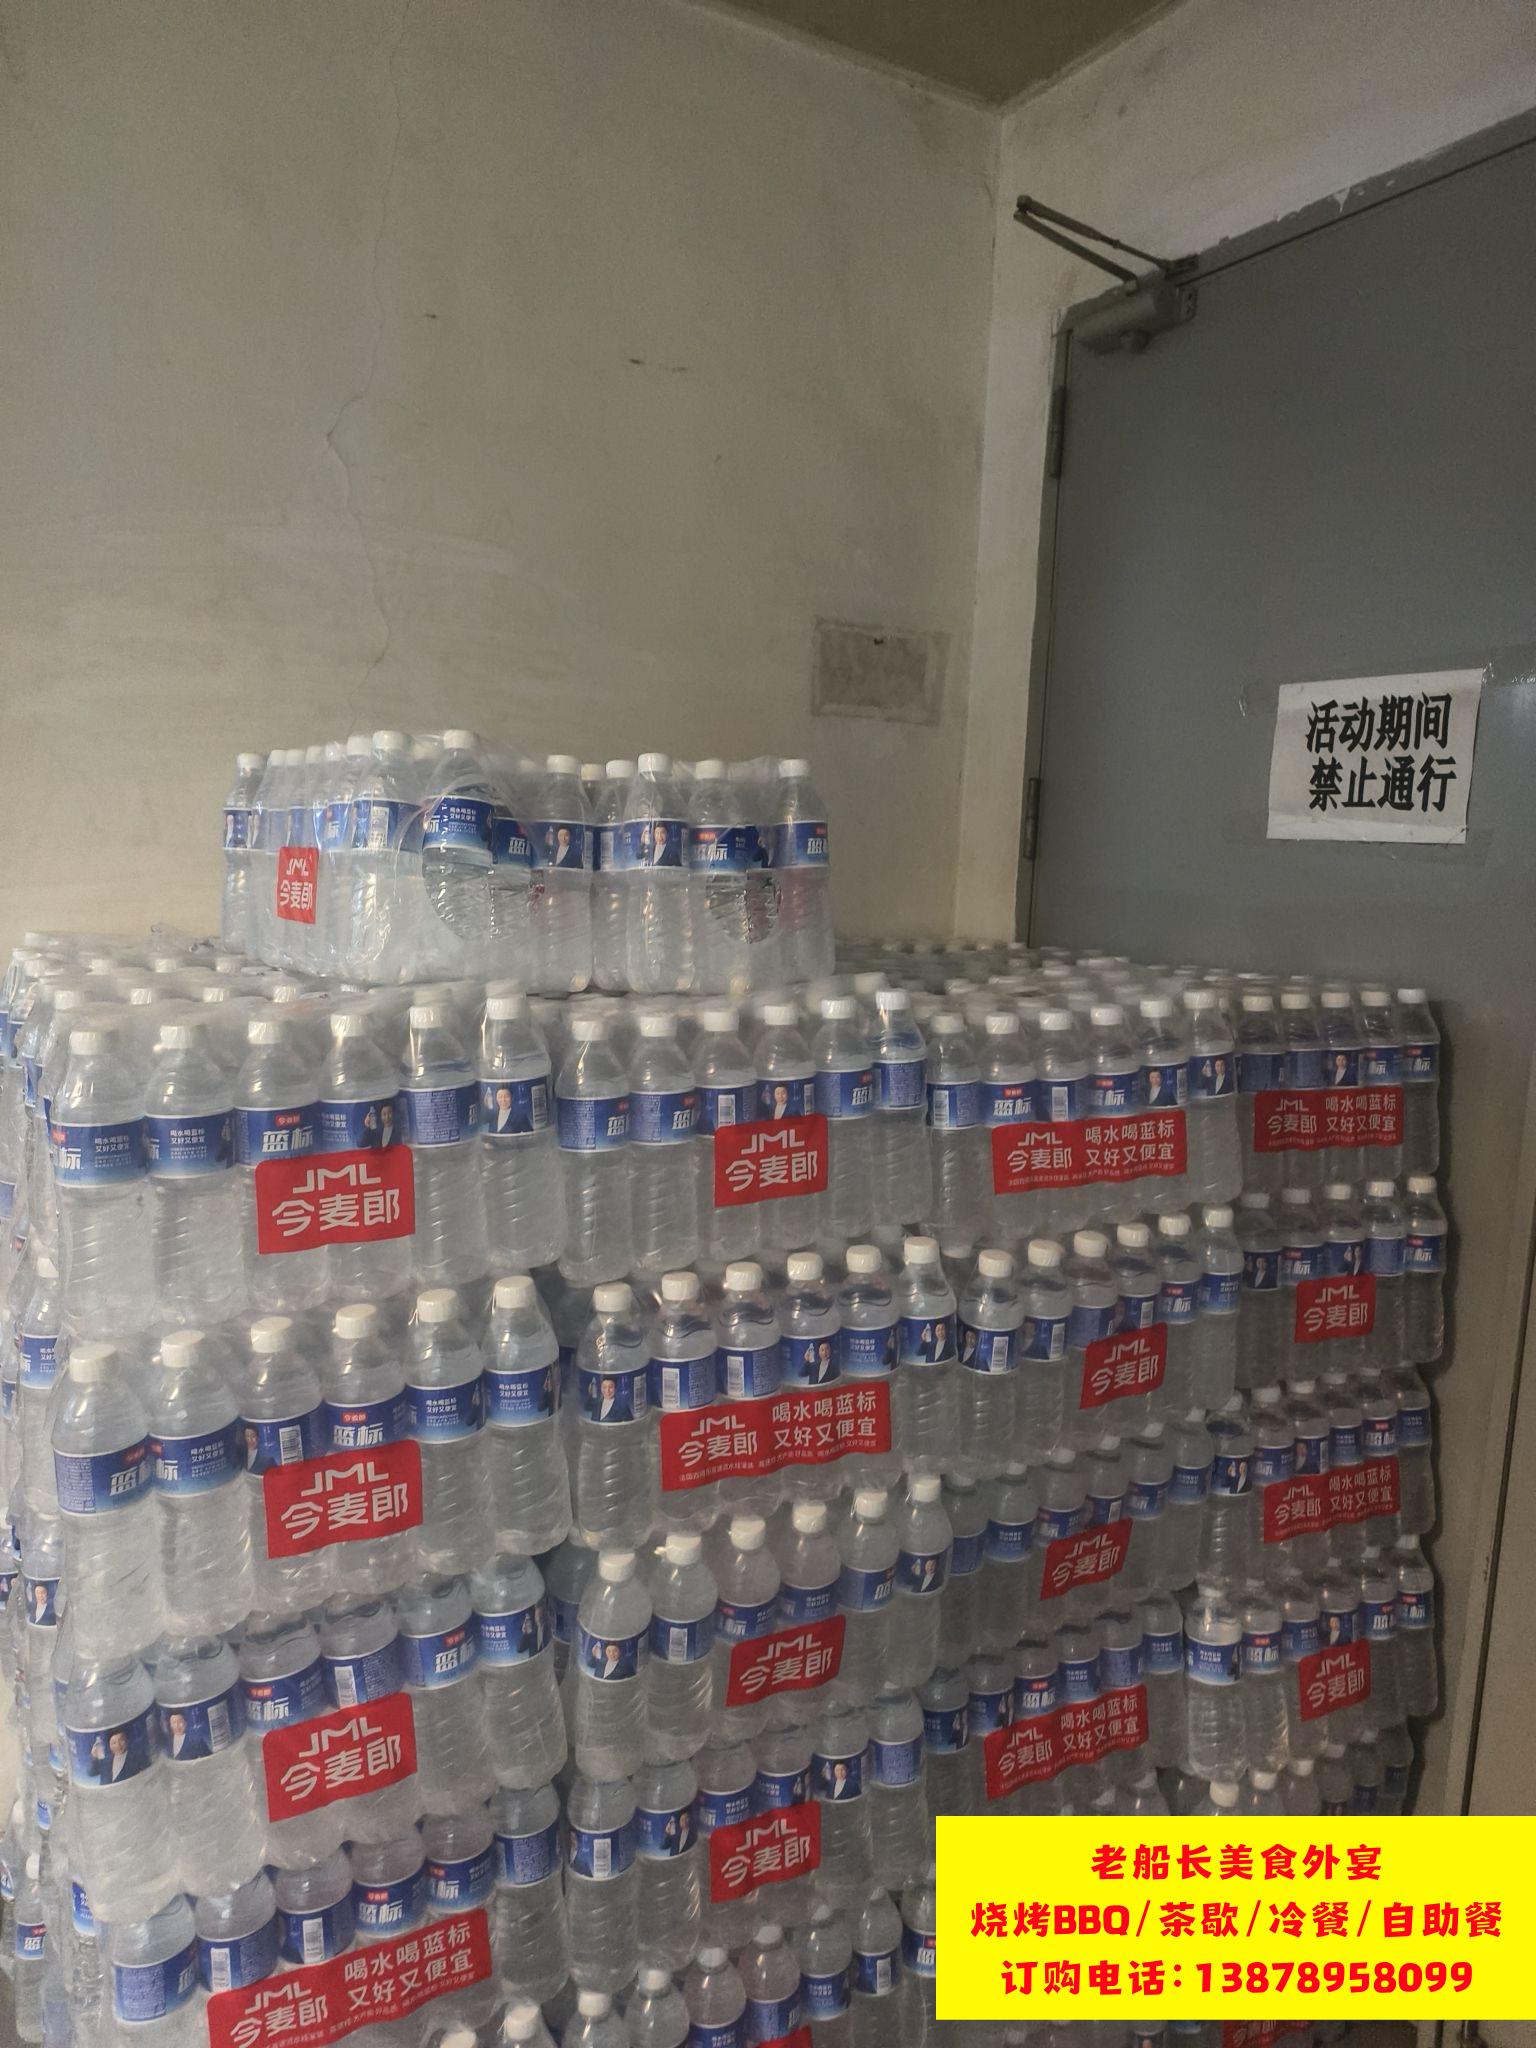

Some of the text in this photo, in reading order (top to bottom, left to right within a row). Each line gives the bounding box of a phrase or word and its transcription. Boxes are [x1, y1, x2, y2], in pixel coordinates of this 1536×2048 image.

[1305, 691, 1453, 754] 活动期间
[1309, 754, 1457, 813] 禁止通行
[286, 857, 310, 878] JML
[279, 879, 314, 911] 今麦郎
[1275, 1098, 1310, 1112] JML
[1325, 1093, 1397, 1114] 喝水喝蓝标
[262, 1125, 313, 1153] 蓝标
[1017, 1132, 1063, 1147] JML
[1085, 1118, 1176, 1146] 喝水喝蓝标
[1266, 1113, 1317, 1136] 今麦郎
[1326, 1114, 1397, 1134] 又好又便宜
[741, 1128, 805, 1155] JML
[1085, 1142, 1176, 1168] 又好又便宜
[725, 1150, 818, 1193] 今麦郎
[1006, 1147, 1073, 1174] 今麦郎
[292, 1163, 382, 1194] JML
[271, 1188, 400, 1237] 今麦郎
[1314, 1284, 1360, 1304] JML
[1303, 1302, 1369, 1333] 今麦郎
[1104, 1338, 1151, 1365] JML
[1090, 1354, 1159, 1396] 今麦郎
[772, 1390, 877, 1424] 喝水喝蓝标
[333, 1423, 384, 1448] 蓝标
[690, 1414, 746, 1437] JML
[774, 1417, 877, 1450] 又好又便宜
[678, 1431, 758, 1468] 今麦郎
[300, 1461, 390, 1497] JML
[1282, 1486, 1315, 1501] JML
[1329, 1464, 1393, 1493] 喝水喝蓝标
[281, 1483, 408, 1540] 今麦郎
[1274, 1498, 1321, 1526] 今麦郎
[1330, 1486, 1393, 1512] 又好又便宜
[1065, 1533, 1114, 1560] JML
[1052, 1546, 1121, 1588] 今麦郎
[756, 1633, 822, 1664] JML
[740, 1647, 833, 1695] 今麦郎
[1316, 1653, 1356, 1679] JML
[1306, 1669, 1365, 1709] 今麦郎
[1060, 1695, 1139, 1731] 喝水喝蓝标
[299, 1716, 383, 1759] JML
[1006, 1727, 1044, 1749] JML
[1062, 1716, 1140, 1753] 又好又便宜
[280, 1734, 401, 1803] 今麦郎
[998, 1741, 1053, 1778] 今麦郎
[735, 1818, 798, 1853] JML
[721, 1835, 811, 1888] 今麦郎
[344, 1921, 472, 1982] 喝水喝蓝标
[349, 1948, 475, 2012] 又好又便宜
[244, 1981, 312, 2014] JML
[230, 1994, 328, 2048] 今麦郎
